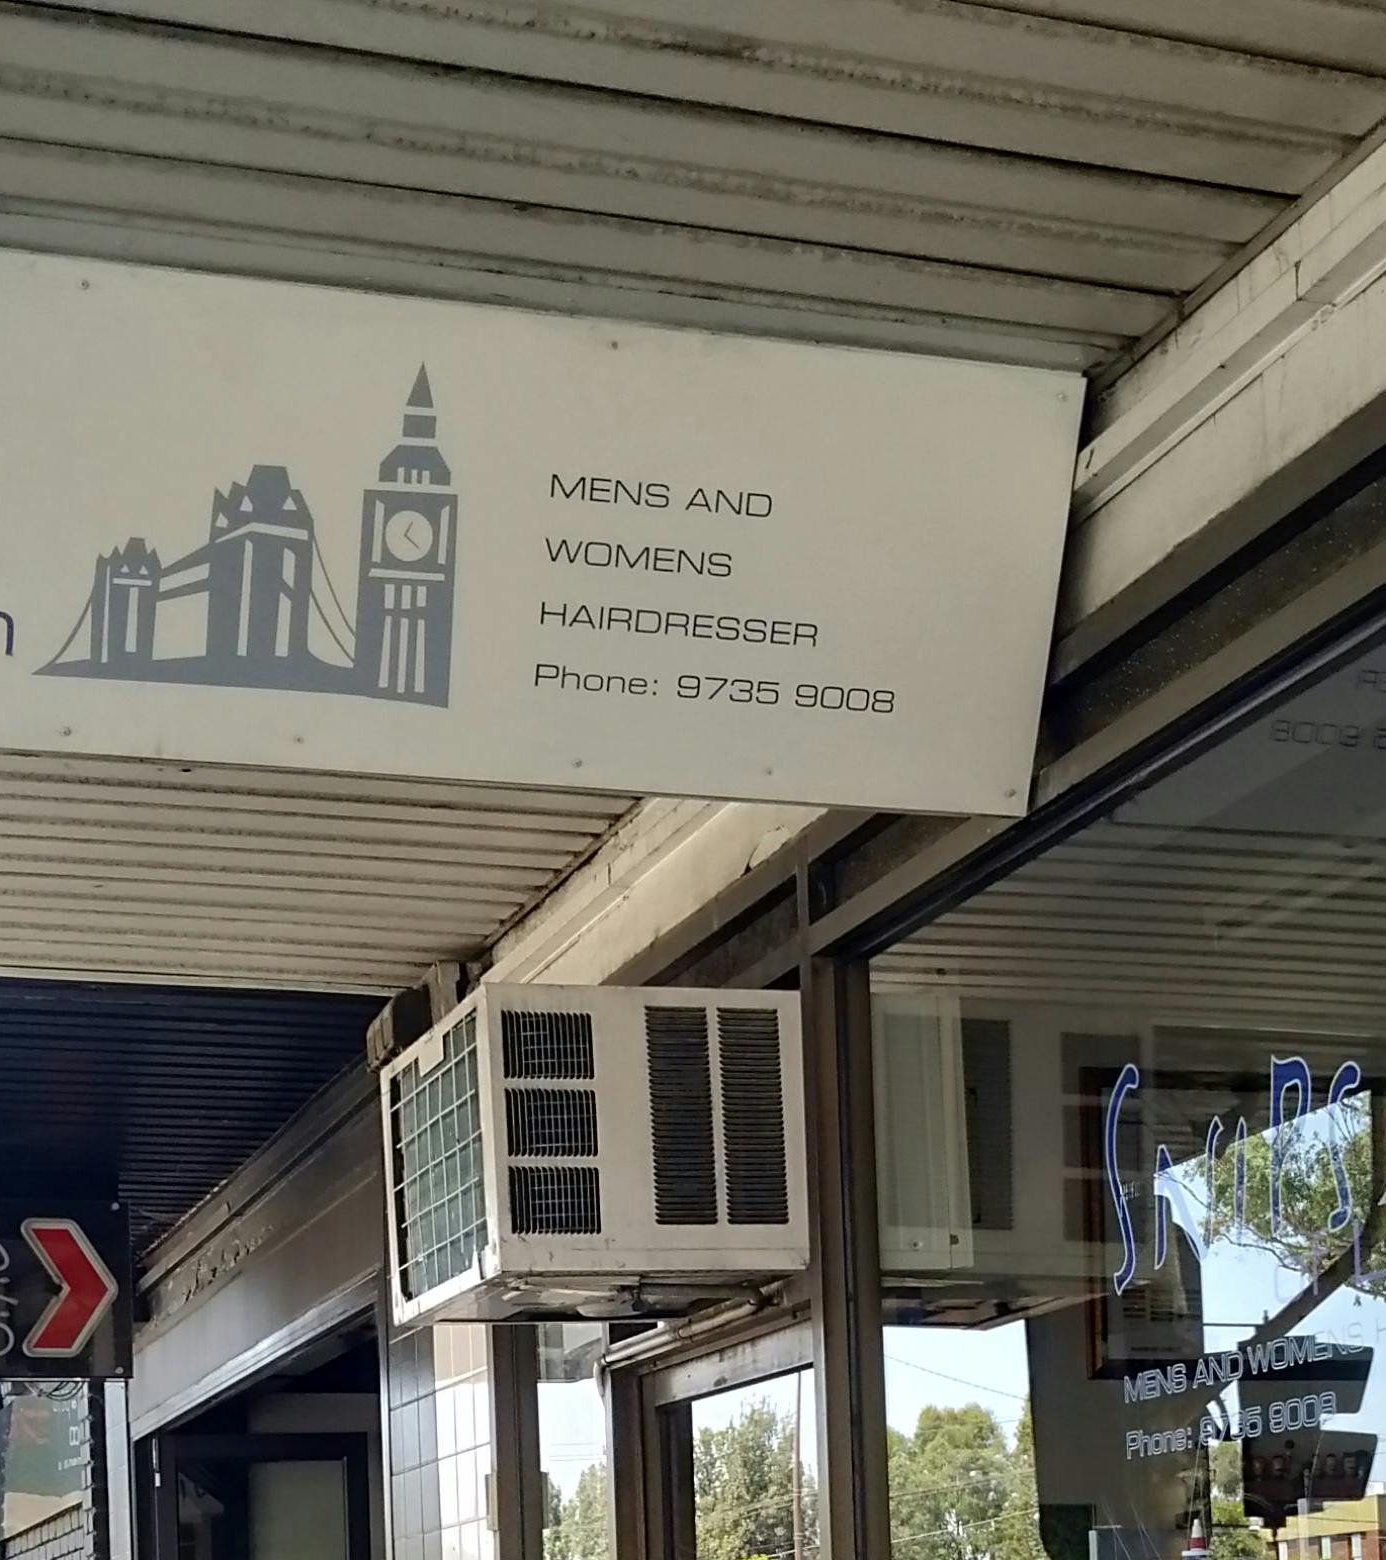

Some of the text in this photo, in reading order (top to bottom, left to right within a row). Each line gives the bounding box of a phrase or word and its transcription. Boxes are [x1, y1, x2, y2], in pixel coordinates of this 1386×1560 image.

[550, 473, 773, 518] MENS AND
[545, 537, 733, 578] WOMENS
[539, 601, 819, 648] HAIRDRESSER
[534, 663, 895, 714] Phone: 9735 9008
[1106, 1054, 1361, 1297] SNIPS
[1123, 1362, 1188, 1404] MENS
[1192, 1350, 1243, 1389] AND
[1246, 1326, 1364, 1375] WOMENS
[1125, 1427, 1193, 1460] Phone:
